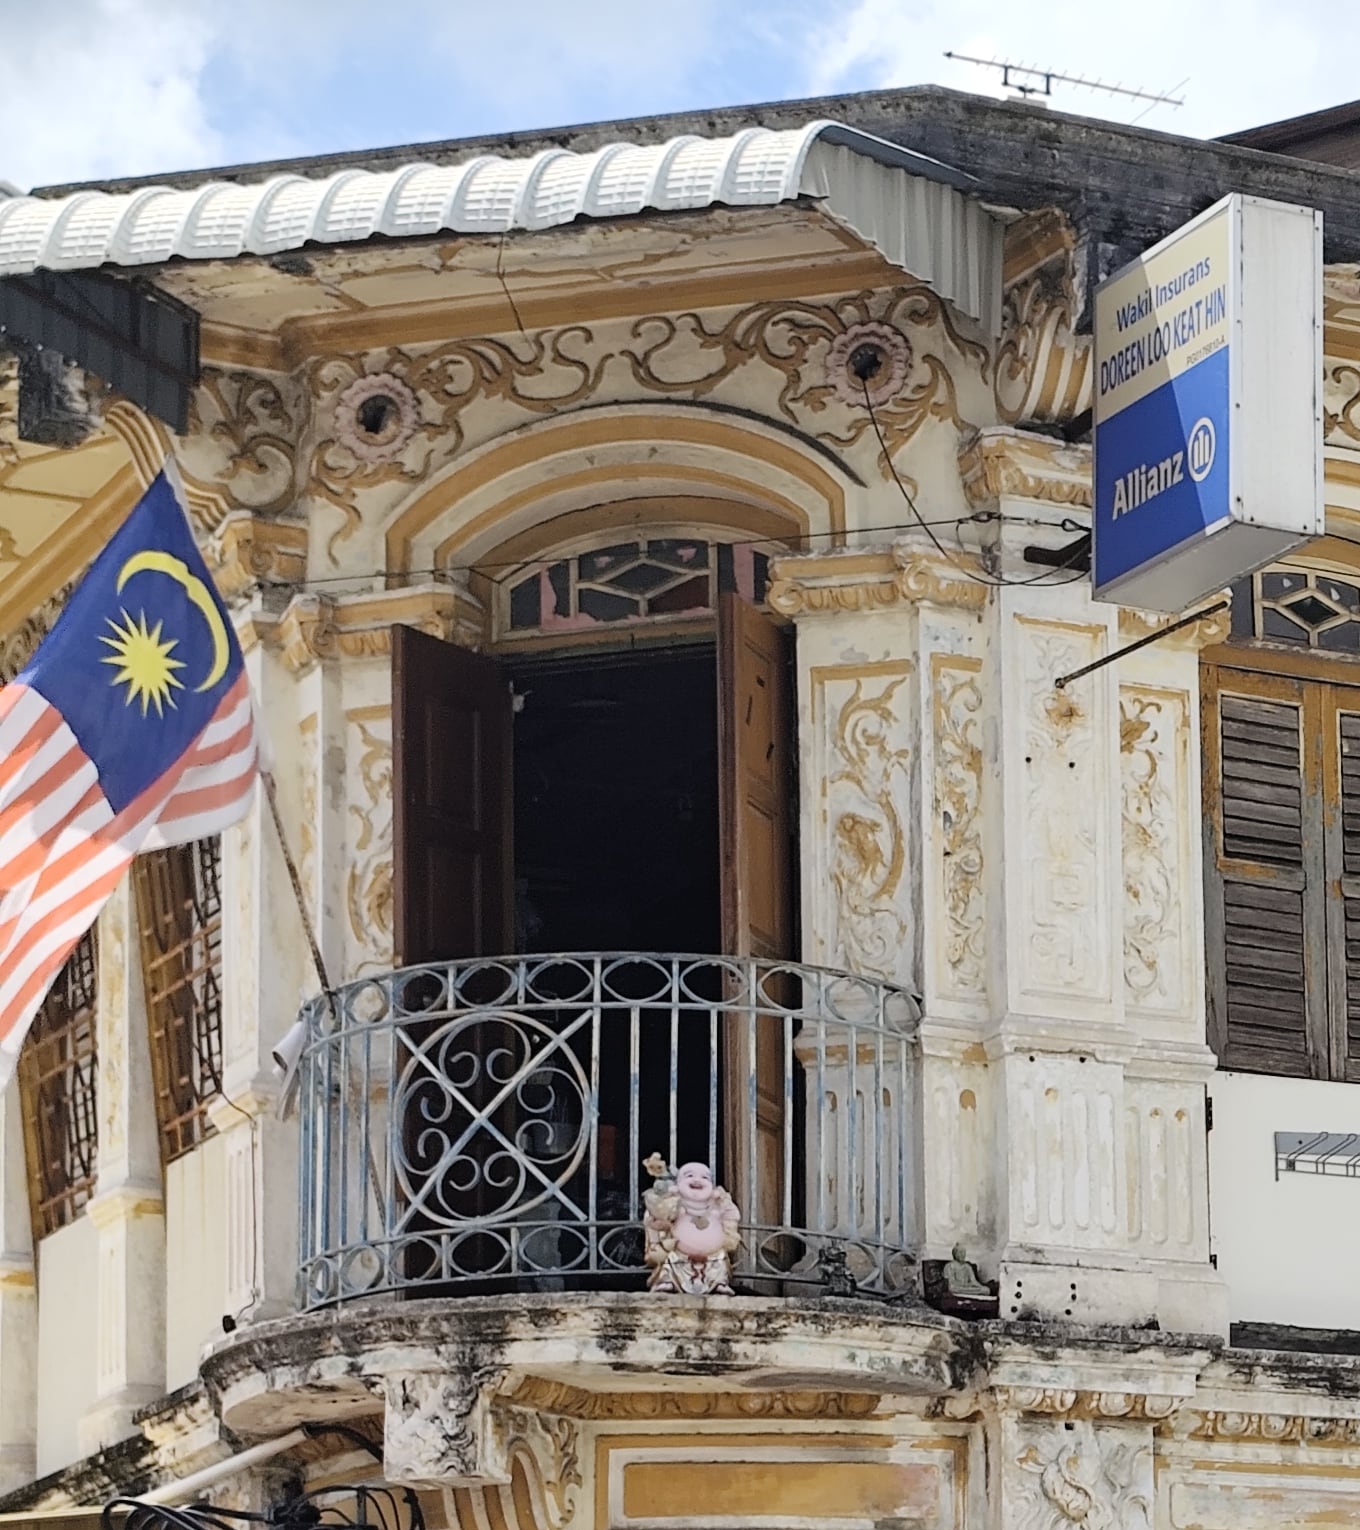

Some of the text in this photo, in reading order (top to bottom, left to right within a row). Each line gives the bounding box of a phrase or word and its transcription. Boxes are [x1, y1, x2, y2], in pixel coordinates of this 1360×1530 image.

[1117, 257, 1210, 332] Wakil Insurans
[1101, 284, 1226, 396] DOREEN LOO KEAT HIN
[1112, 450, 1184, 521] Allianz
